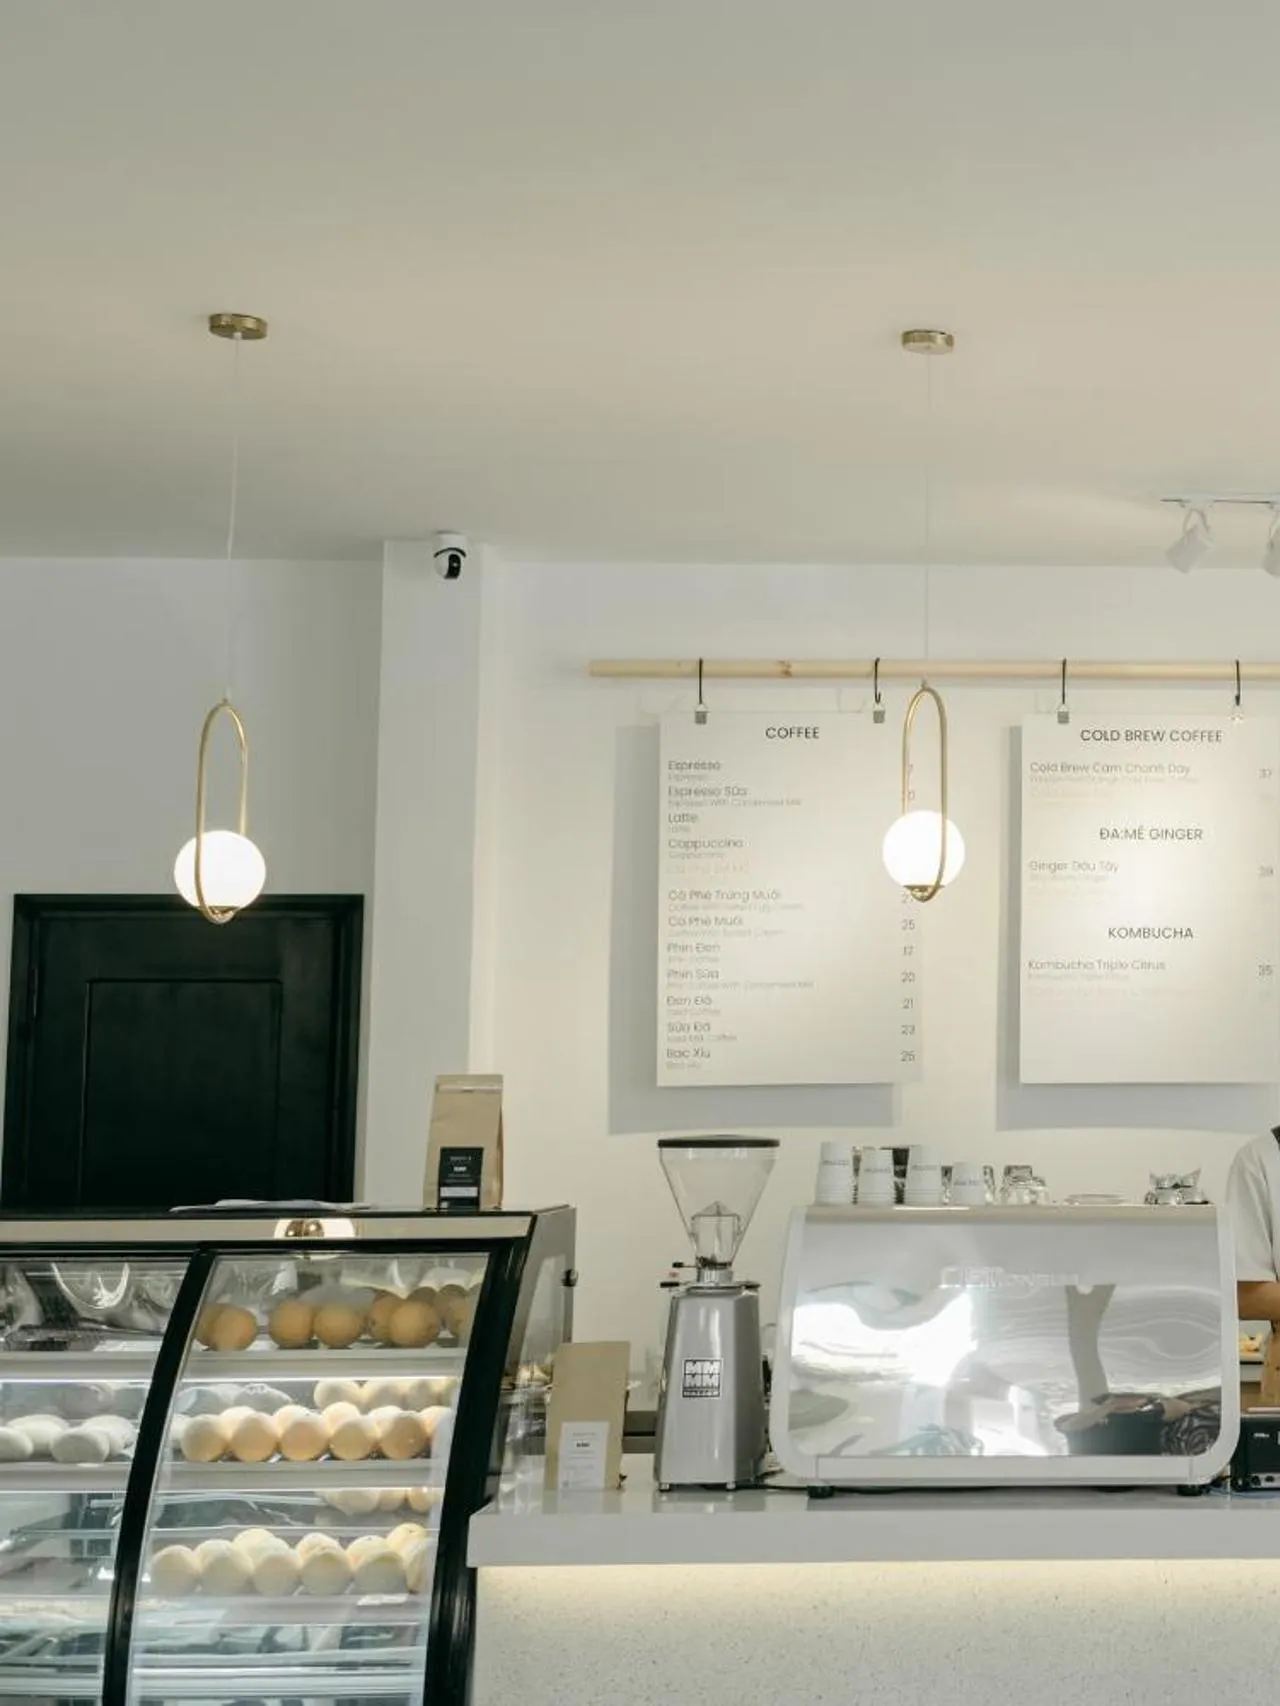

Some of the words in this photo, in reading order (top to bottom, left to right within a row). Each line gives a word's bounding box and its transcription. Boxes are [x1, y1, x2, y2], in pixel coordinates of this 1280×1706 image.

[765, 727, 820, 739] COFFEE
[1080, 729, 1120, 742] COLD
[1125, 729, 1165, 742] BREW
[1169, 730, 1222, 743] COFFEE
[668, 760, 721, 771] Espresso
[1030, 762, 1058, 773] Cold
[1060, 762, 1089, 773] Brew
[1093, 762, 1122, 773] Cam
[668, 787, 721, 798] Espresso
[1149, 828, 1204, 841] GINGER
[668, 839, 743, 851] Cappuccino
[1029, 860, 1069, 873] Ginger
[1108, 927, 1194, 939] KOMBUCHA
[1028, 959, 1095, 970] Kombucha
